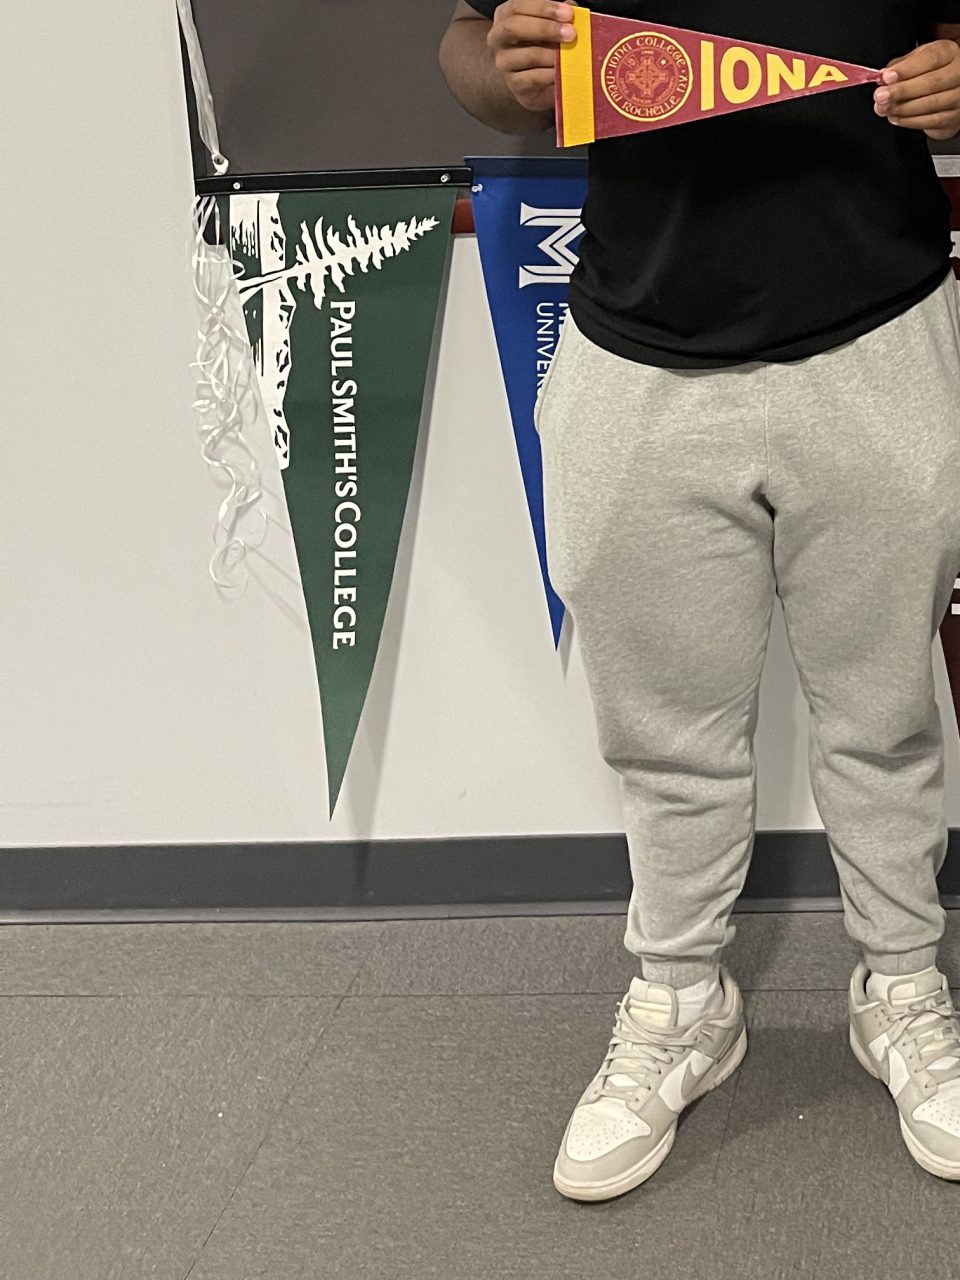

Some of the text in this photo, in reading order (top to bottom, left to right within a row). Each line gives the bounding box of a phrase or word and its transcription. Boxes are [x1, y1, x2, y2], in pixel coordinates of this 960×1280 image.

[700, 39, 849, 111] IONA
[330, 300, 362, 650] PAUL SMITH'S COLLEGE
